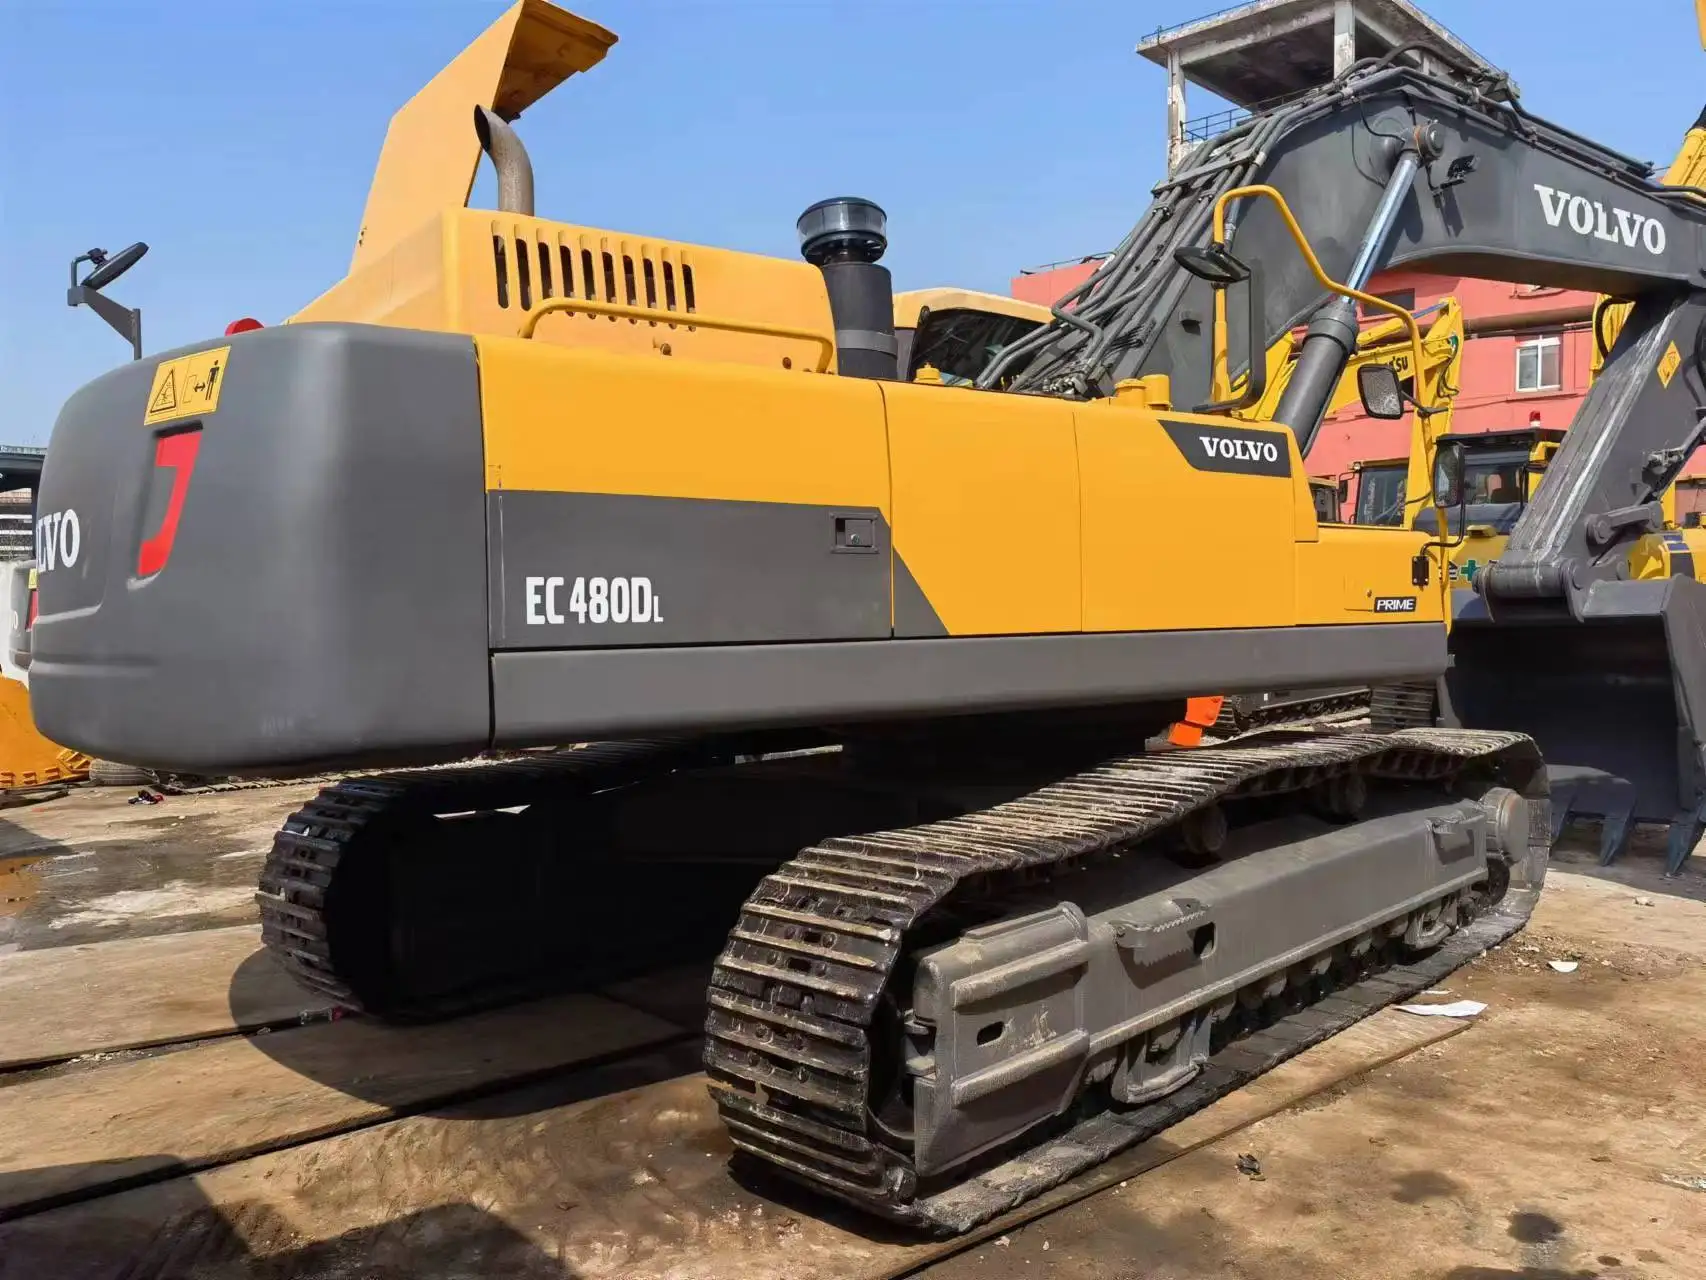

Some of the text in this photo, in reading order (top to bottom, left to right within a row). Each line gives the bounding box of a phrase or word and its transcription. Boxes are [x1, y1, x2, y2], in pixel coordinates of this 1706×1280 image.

[1533, 184, 1666, 255] VOLVO
[1198, 436, 1278, 464] VOLVO
[1376, 597, 1416, 612] PRIME
